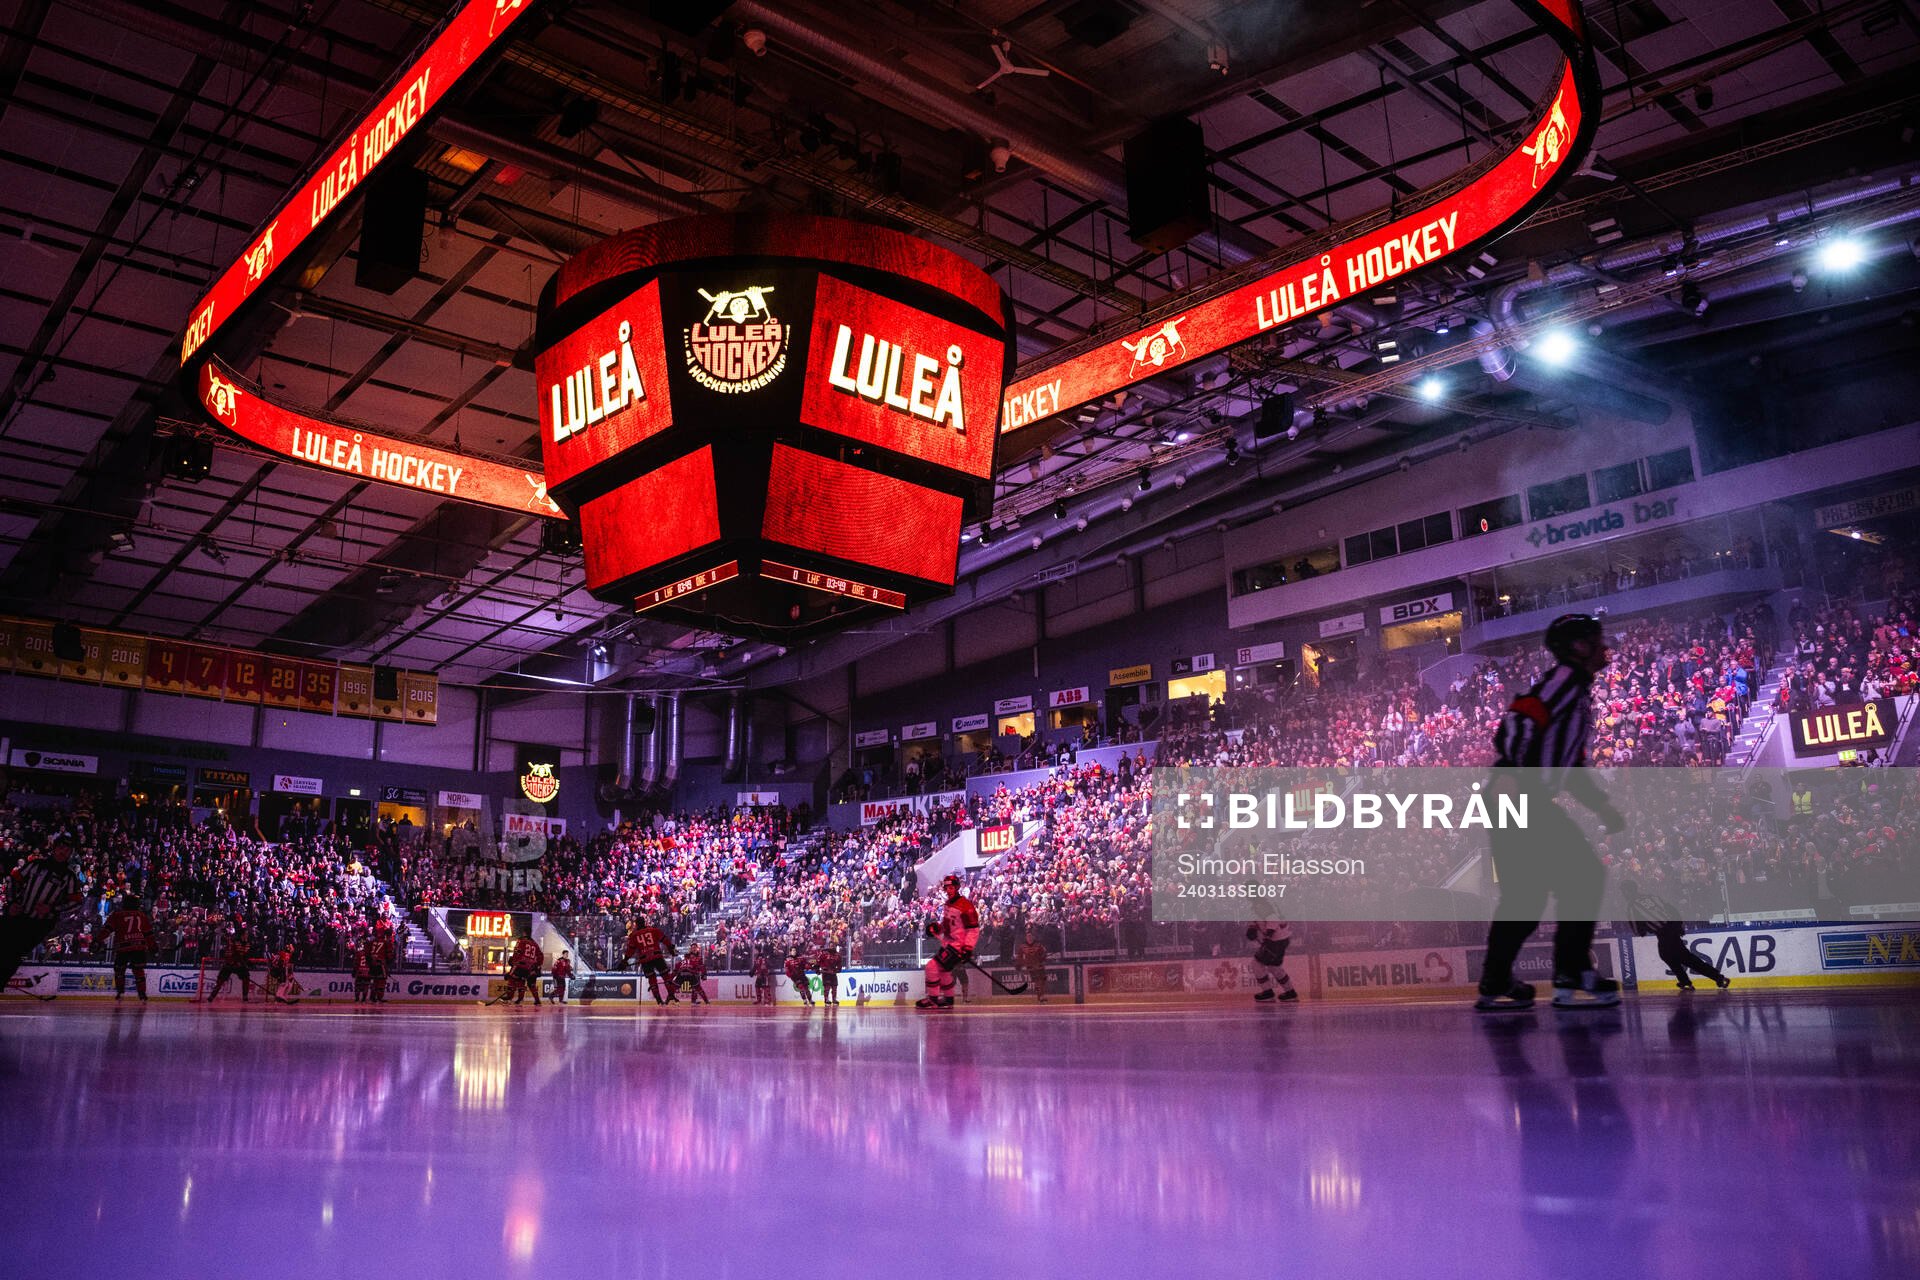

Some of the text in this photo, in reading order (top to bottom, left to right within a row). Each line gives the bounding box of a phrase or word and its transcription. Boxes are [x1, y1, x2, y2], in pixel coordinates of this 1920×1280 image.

[311, 67, 430, 228] LULEÅ HOCKEY
[1256, 211, 1458, 330] LULEÅ HOCKEY
[181, 301, 215, 367] OCKEY
[691, 318, 782, 343] LULEÅ
[692, 341, 781, 380] HOCKEY
[552, 320, 645, 442] LULEÅ
[829, 324, 965, 430] LULEÅ
[1002, 379, 1062, 431] OCKEY
[292, 427, 463, 494] LULEÅ HOCKEY
[1545, 497, 1678, 545] bravida bar
[792, 570, 799, 581] 0
[806, 573, 820, 585] LHF
[1393, 598, 1439, 620] BDX
[111, 648, 140, 665] 2016
[162, 651, 176, 674] 4
[201, 657, 214, 678] 7
[235, 662, 256, 686] 12
[272, 667, 296, 690] 28
[306, 672, 331, 695] 35
[1113, 668, 1149, 682] Assemblin
[343, 681, 367, 695] 1996
[1056, 689, 1083, 705] ABB
[1802, 703, 1885, 746] LULEÅ
[43, 756, 86, 768] SCANIA
[205, 769, 248, 782] TITAN
[526, 773, 556, 785] LULEÅ
[509, 817, 548, 832] MAXI
[980, 827, 1016, 852] LULEÅ
[123, 915, 142, 932] 71
[466, 913, 513, 937] LULEÅ
[524, 944, 536, 958] 23
[636, 932, 655, 947] 43
[1327, 963, 1424, 987] NIEMI BIL
[407, 981, 481, 996] Granec
[860, 980, 910, 994] LINDBÄCKS
